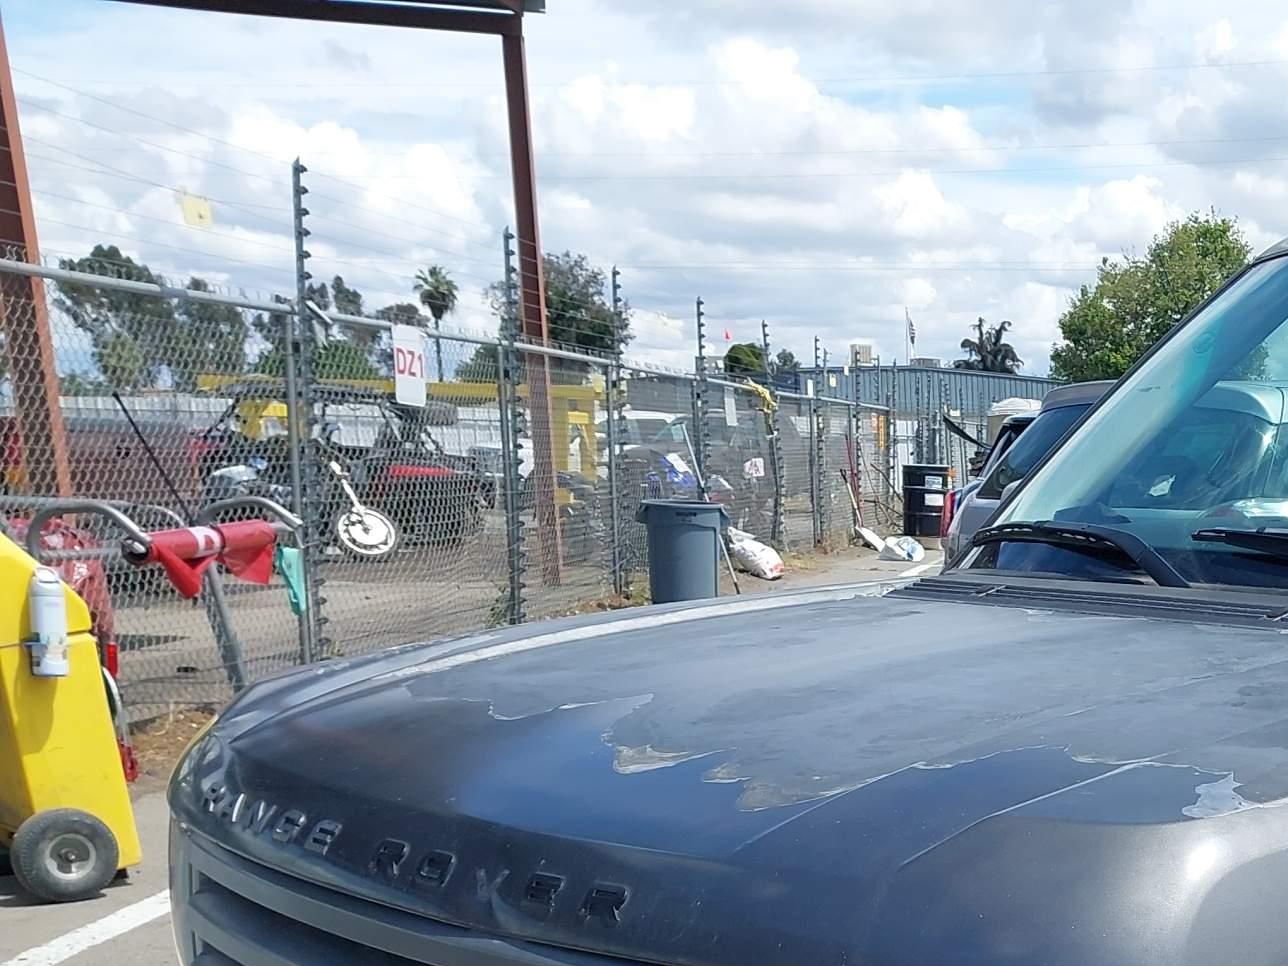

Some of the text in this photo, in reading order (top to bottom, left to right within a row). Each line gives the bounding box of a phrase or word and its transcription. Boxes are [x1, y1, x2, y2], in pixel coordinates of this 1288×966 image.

[396, 347, 424, 379] DZ1
[202, 783, 632, 925] RANGE ROVER
